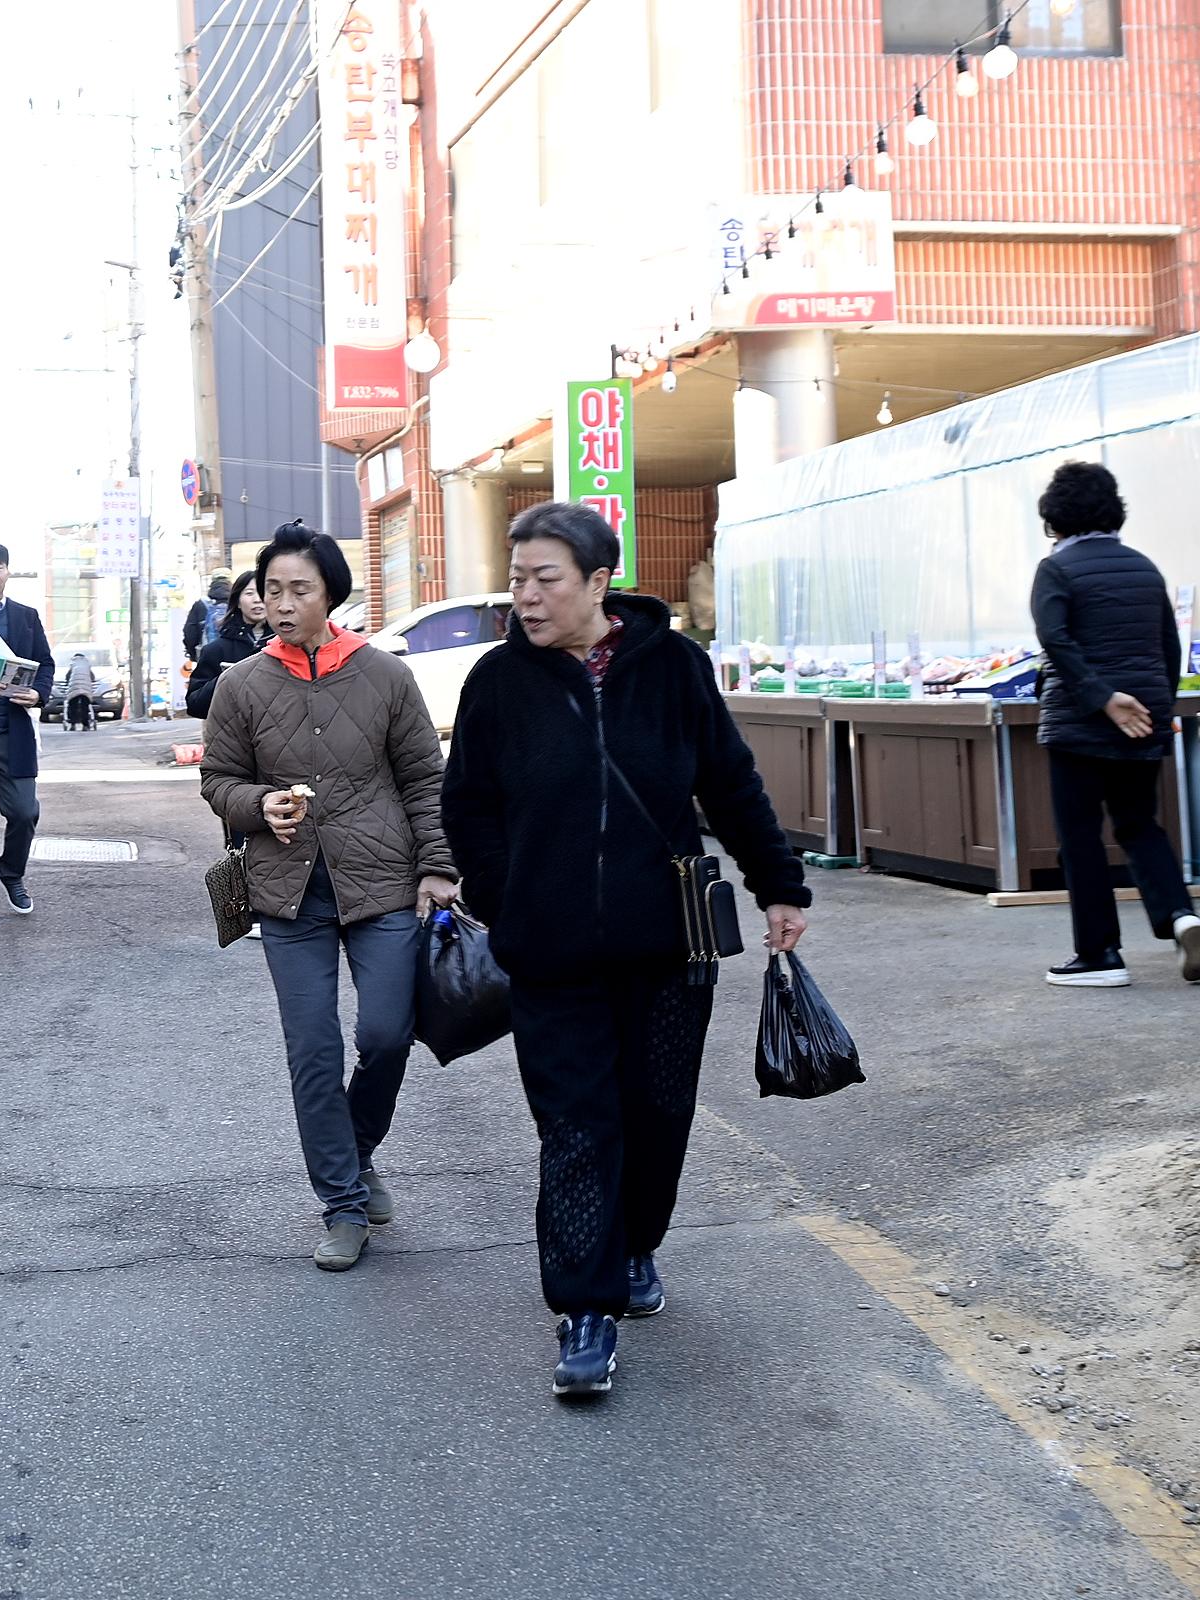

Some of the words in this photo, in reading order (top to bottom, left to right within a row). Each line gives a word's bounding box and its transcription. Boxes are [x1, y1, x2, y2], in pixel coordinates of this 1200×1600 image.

[342, 8, 378, 306] 송탄부대찌개
[381, 53, 400, 170] 쑥고개식당
[776, 296, 875, 318] 메기매운탕
